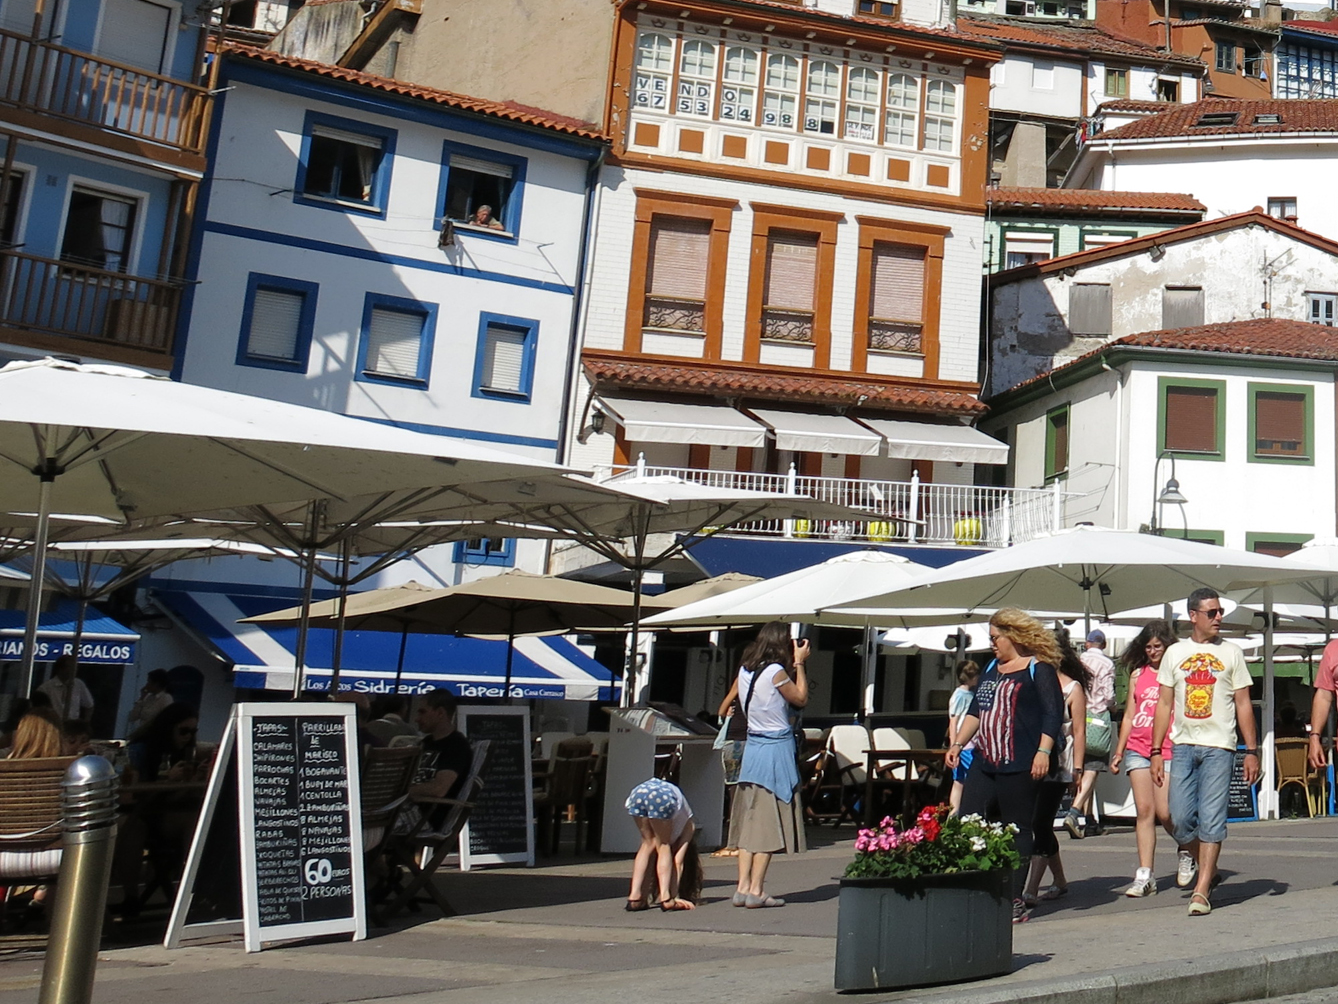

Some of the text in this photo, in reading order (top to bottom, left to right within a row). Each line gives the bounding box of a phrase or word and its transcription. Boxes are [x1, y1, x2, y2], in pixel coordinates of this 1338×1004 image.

[325, 680, 351, 692] Acos
[1141, 686, 1159, 699] Th
[304, 858, 333, 885] 60
[310, 884, 352, 899] PERSONAS
